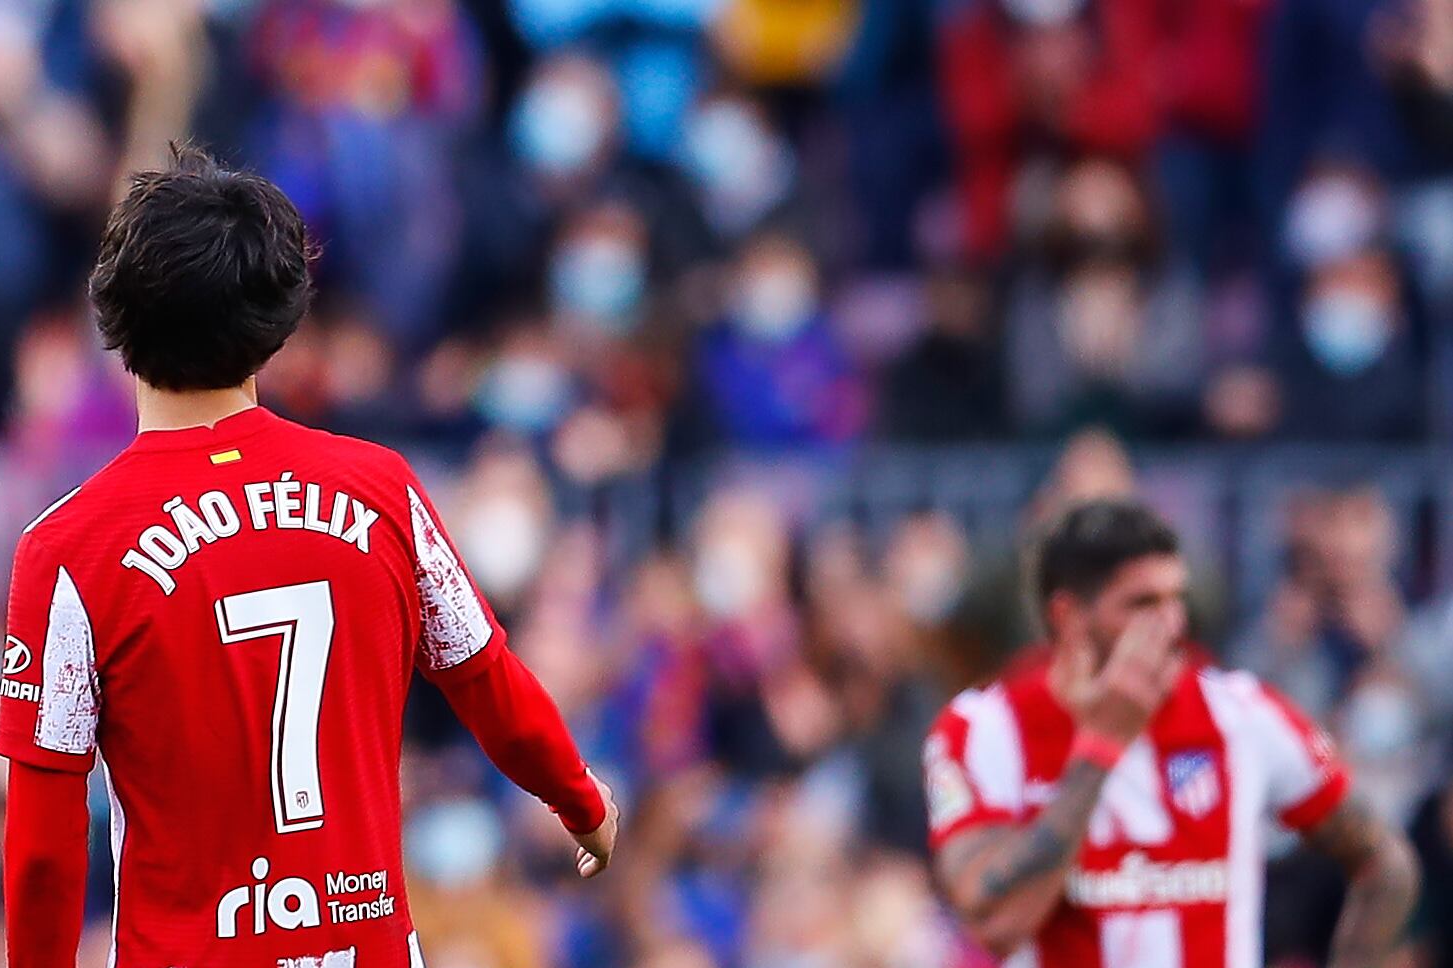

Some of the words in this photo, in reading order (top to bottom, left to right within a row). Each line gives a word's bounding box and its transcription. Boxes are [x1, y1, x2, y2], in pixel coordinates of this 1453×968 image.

[120, 489, 241, 596] JOÃO
[243, 471, 380, 553] FÉLIX
[213, 580, 335, 834] 7
[217, 856, 321, 938] ria
[326, 870, 387, 893] Money
[327, 893, 395, 923] Transfer
